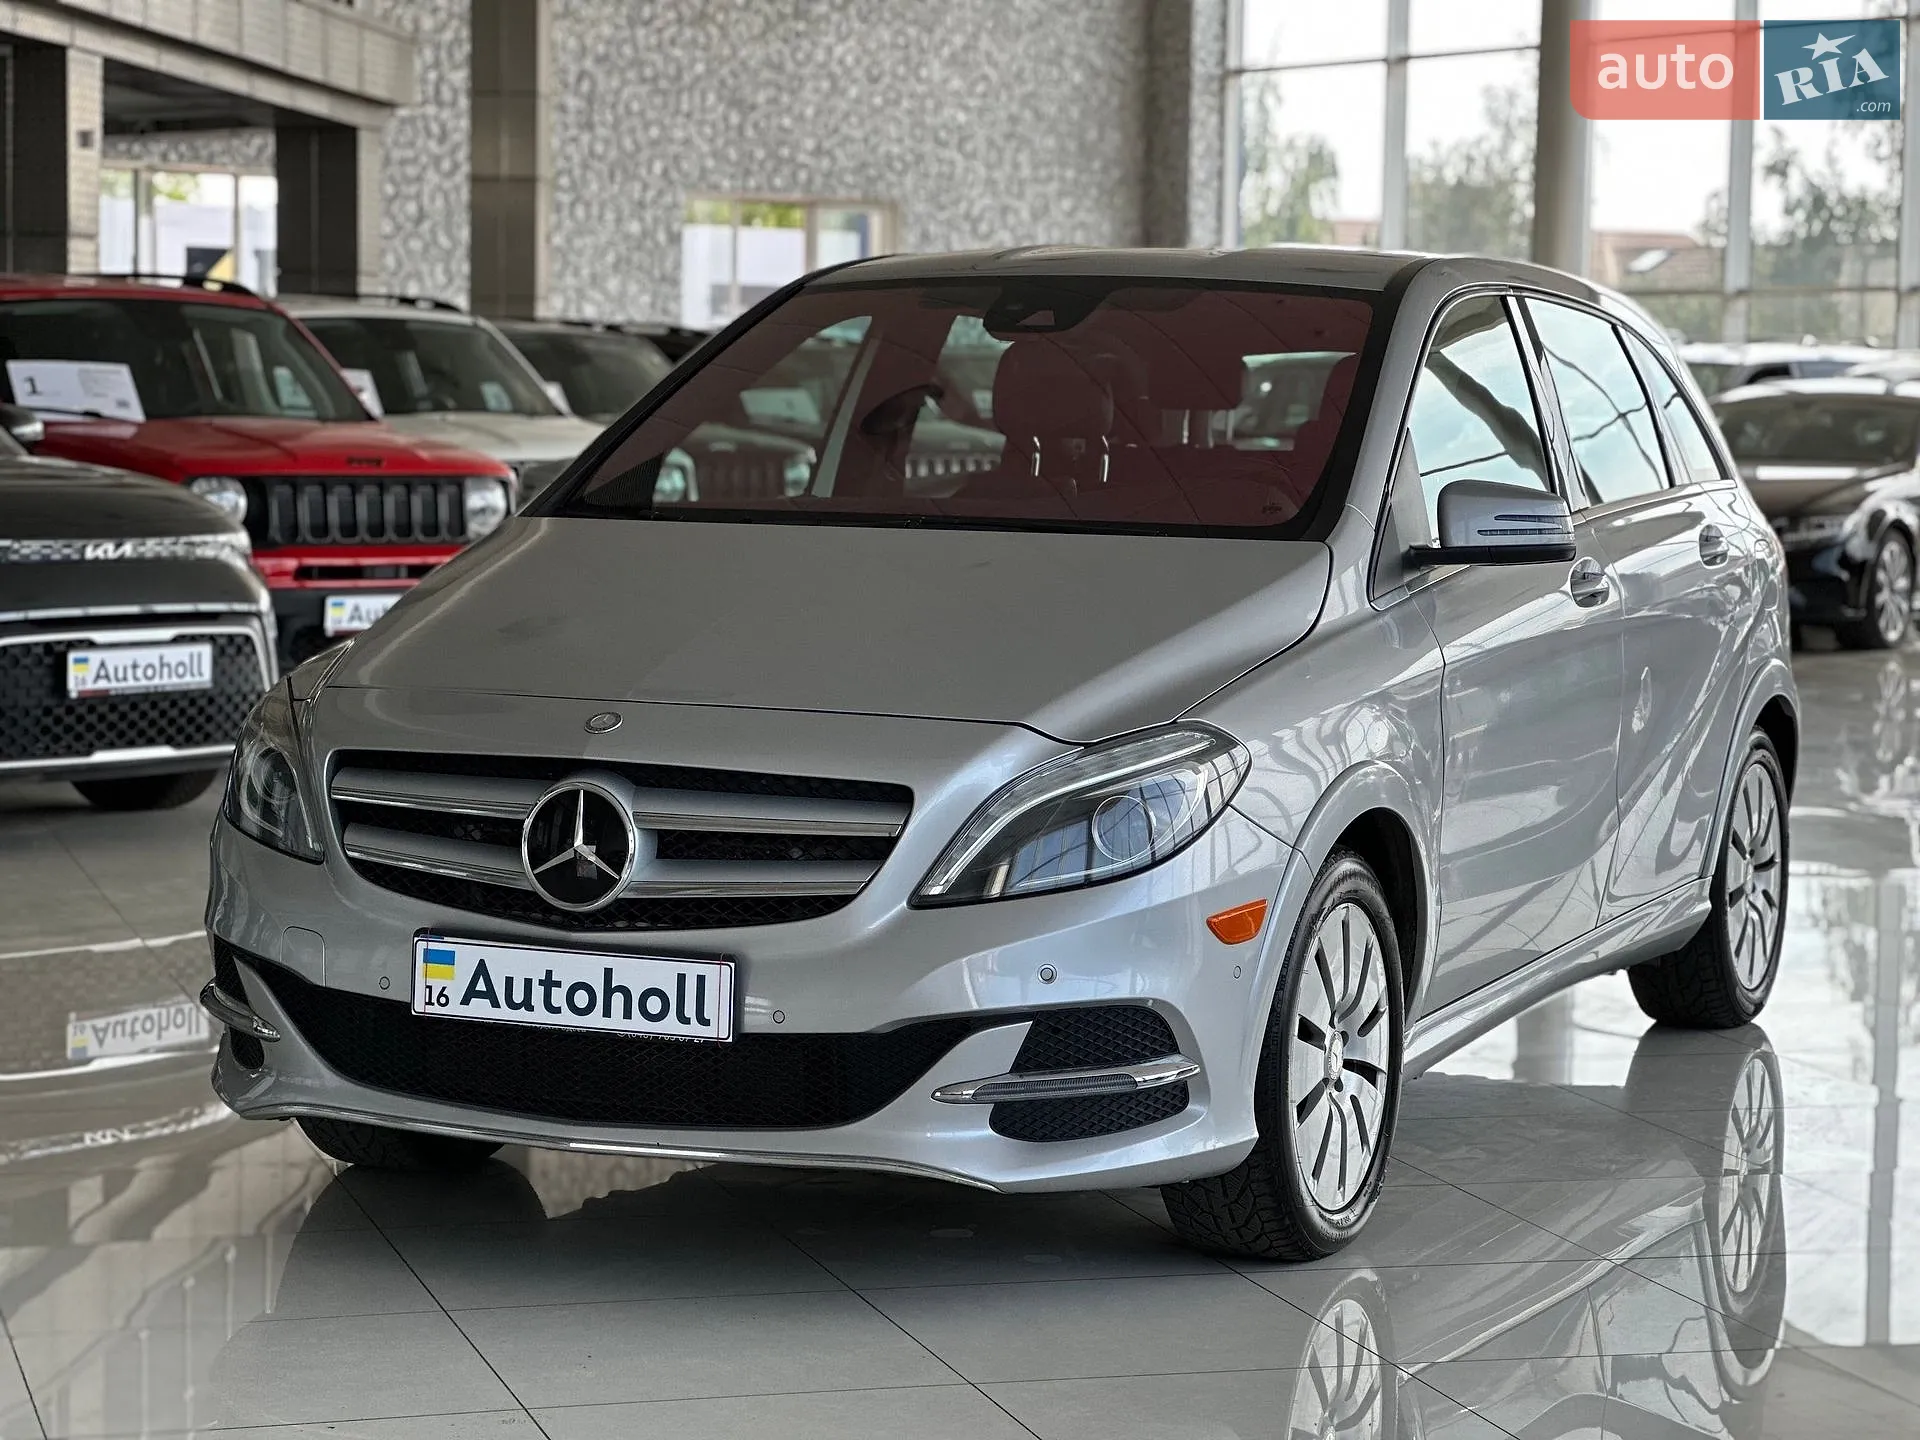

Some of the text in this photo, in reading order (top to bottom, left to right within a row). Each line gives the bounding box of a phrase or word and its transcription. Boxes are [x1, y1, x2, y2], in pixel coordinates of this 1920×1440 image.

[23, 376, 42, 396] 1
[346, 602, 389, 624] Au
[93, 651, 204, 684] Autoholl
[425, 985, 449, 1008] 16
[459, 958, 711, 1026] Autoholl
